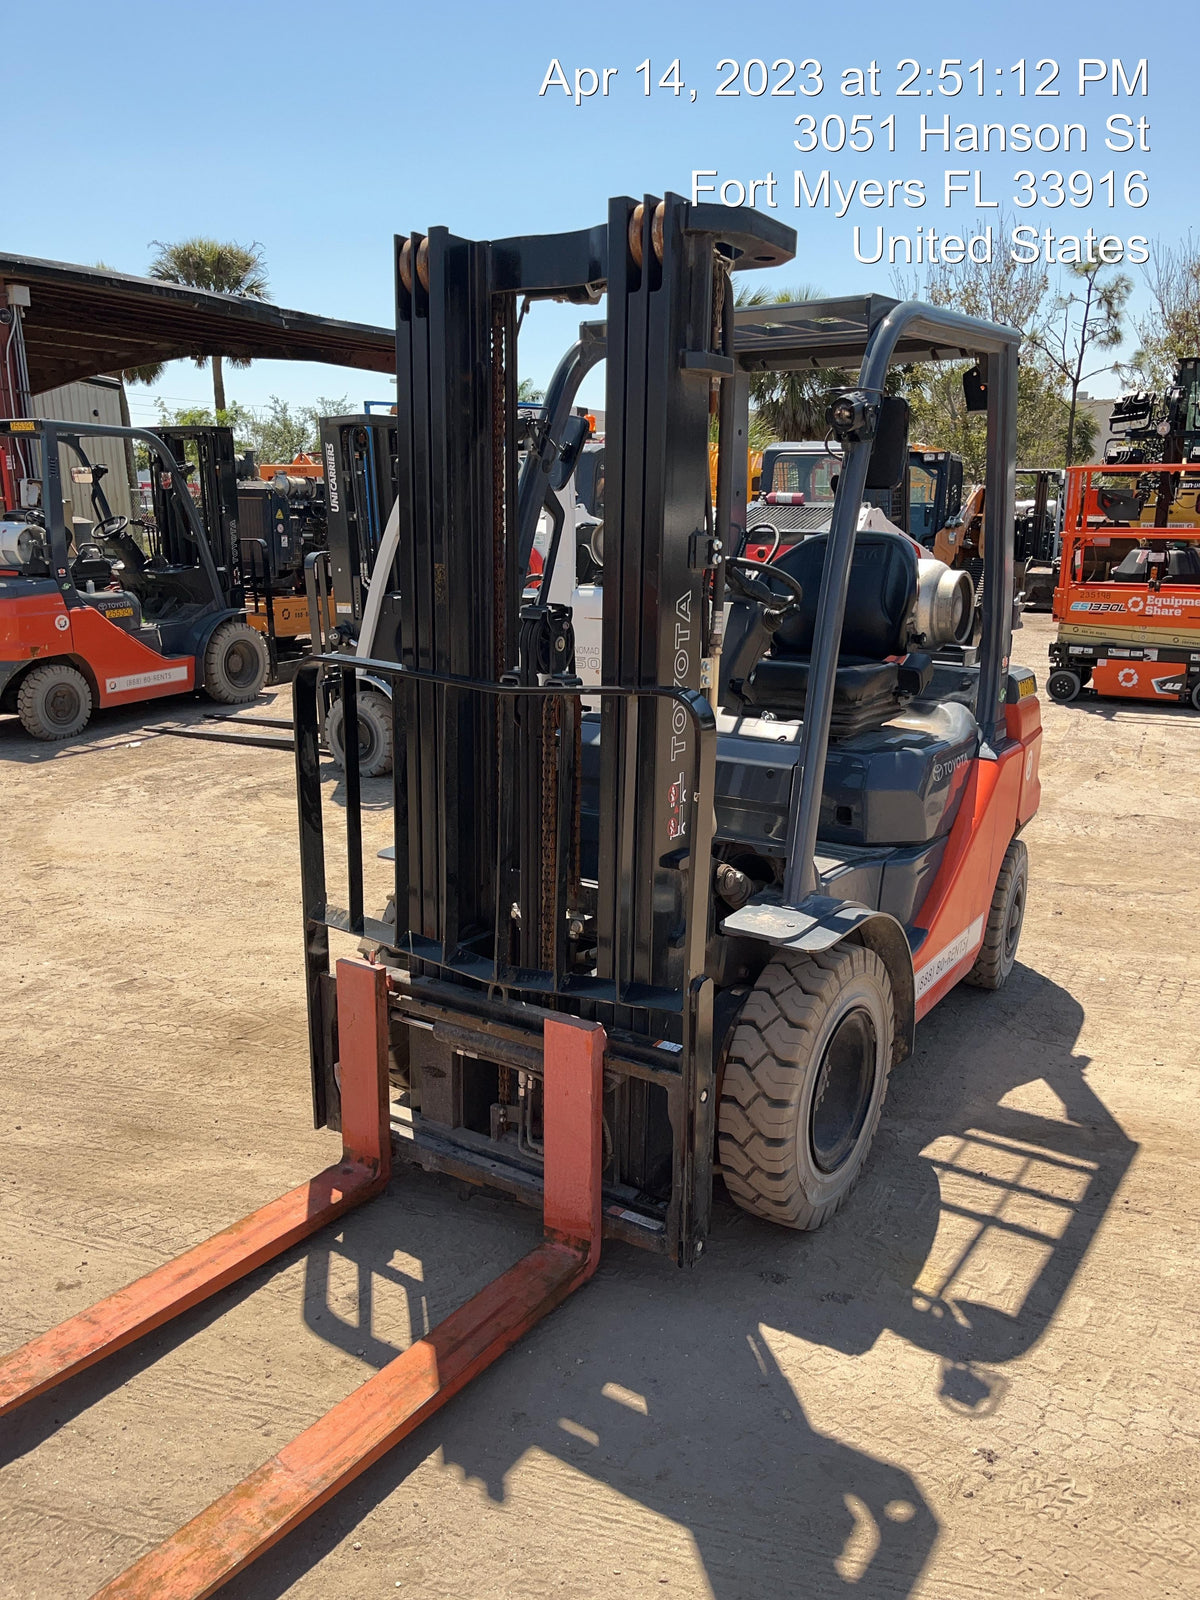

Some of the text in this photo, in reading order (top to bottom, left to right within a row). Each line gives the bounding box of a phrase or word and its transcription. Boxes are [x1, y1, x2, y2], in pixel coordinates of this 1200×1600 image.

[325, 442, 340, 513] UNICARRIERS
[1070, 601, 1127, 613] ES1330L
[1146, 595, 1200, 607] Equipme
[1145, 606, 1182, 616] Share
[1162, 682, 1183, 690] JLG
[943, 752, 969, 776] TOYOTA
